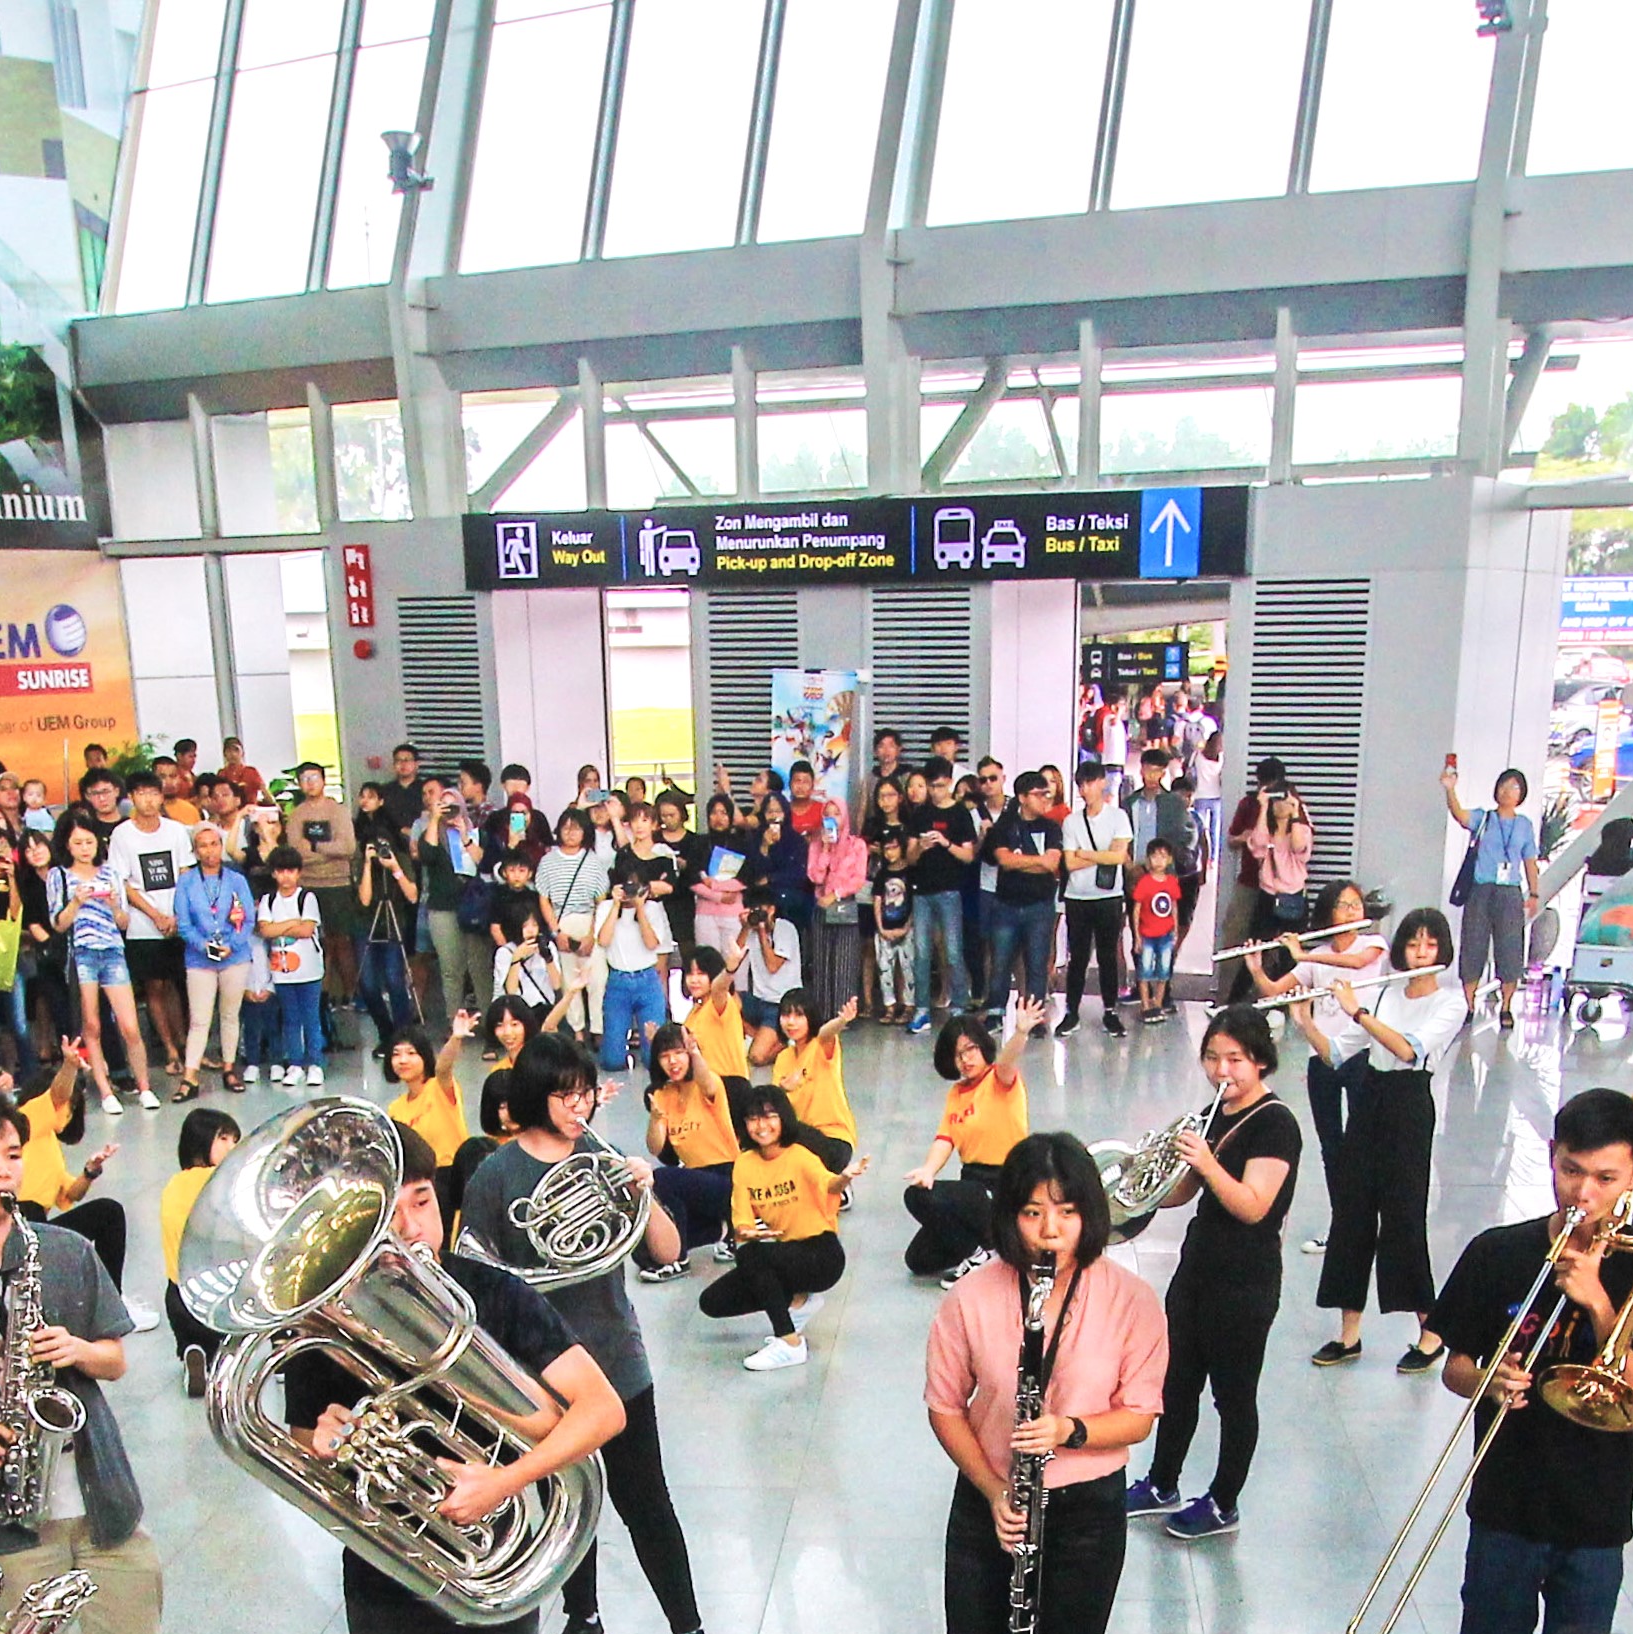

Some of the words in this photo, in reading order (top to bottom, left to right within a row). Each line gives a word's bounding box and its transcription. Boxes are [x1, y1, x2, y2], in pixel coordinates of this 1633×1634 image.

[715, 516, 742, 531] Zon
[744, 513, 818, 532] Mengambil
[821, 512, 848, 527] dan
[1046, 515, 1075, 531] Bas
[1078, 515, 1084, 531] /
[1087, 513, 1129, 530] Teksi
[551, 530, 594, 546] Keluar
[716, 533, 800, 551] Menurunkan
[803, 533, 885, 550] Penumpang
[1046, 537, 1076, 552] Bus
[1078, 536, 1085, 552] /
[1088, 536, 1120, 551] Taxi
[552, 551, 579, 567] Way
[581, 549, 606, 564] Out
[716, 554, 768, 572] Pick-up
[770, 553, 795, 569] and
[799, 552, 856, 570] Drop-off
[858, 553, 895, 568] Zone
[16, 667, 90, 691] SUNRISE
[19, 717, 35, 733] of
[36, 715, 70, 731] UEM
[72, 715, 116, 734] Group
